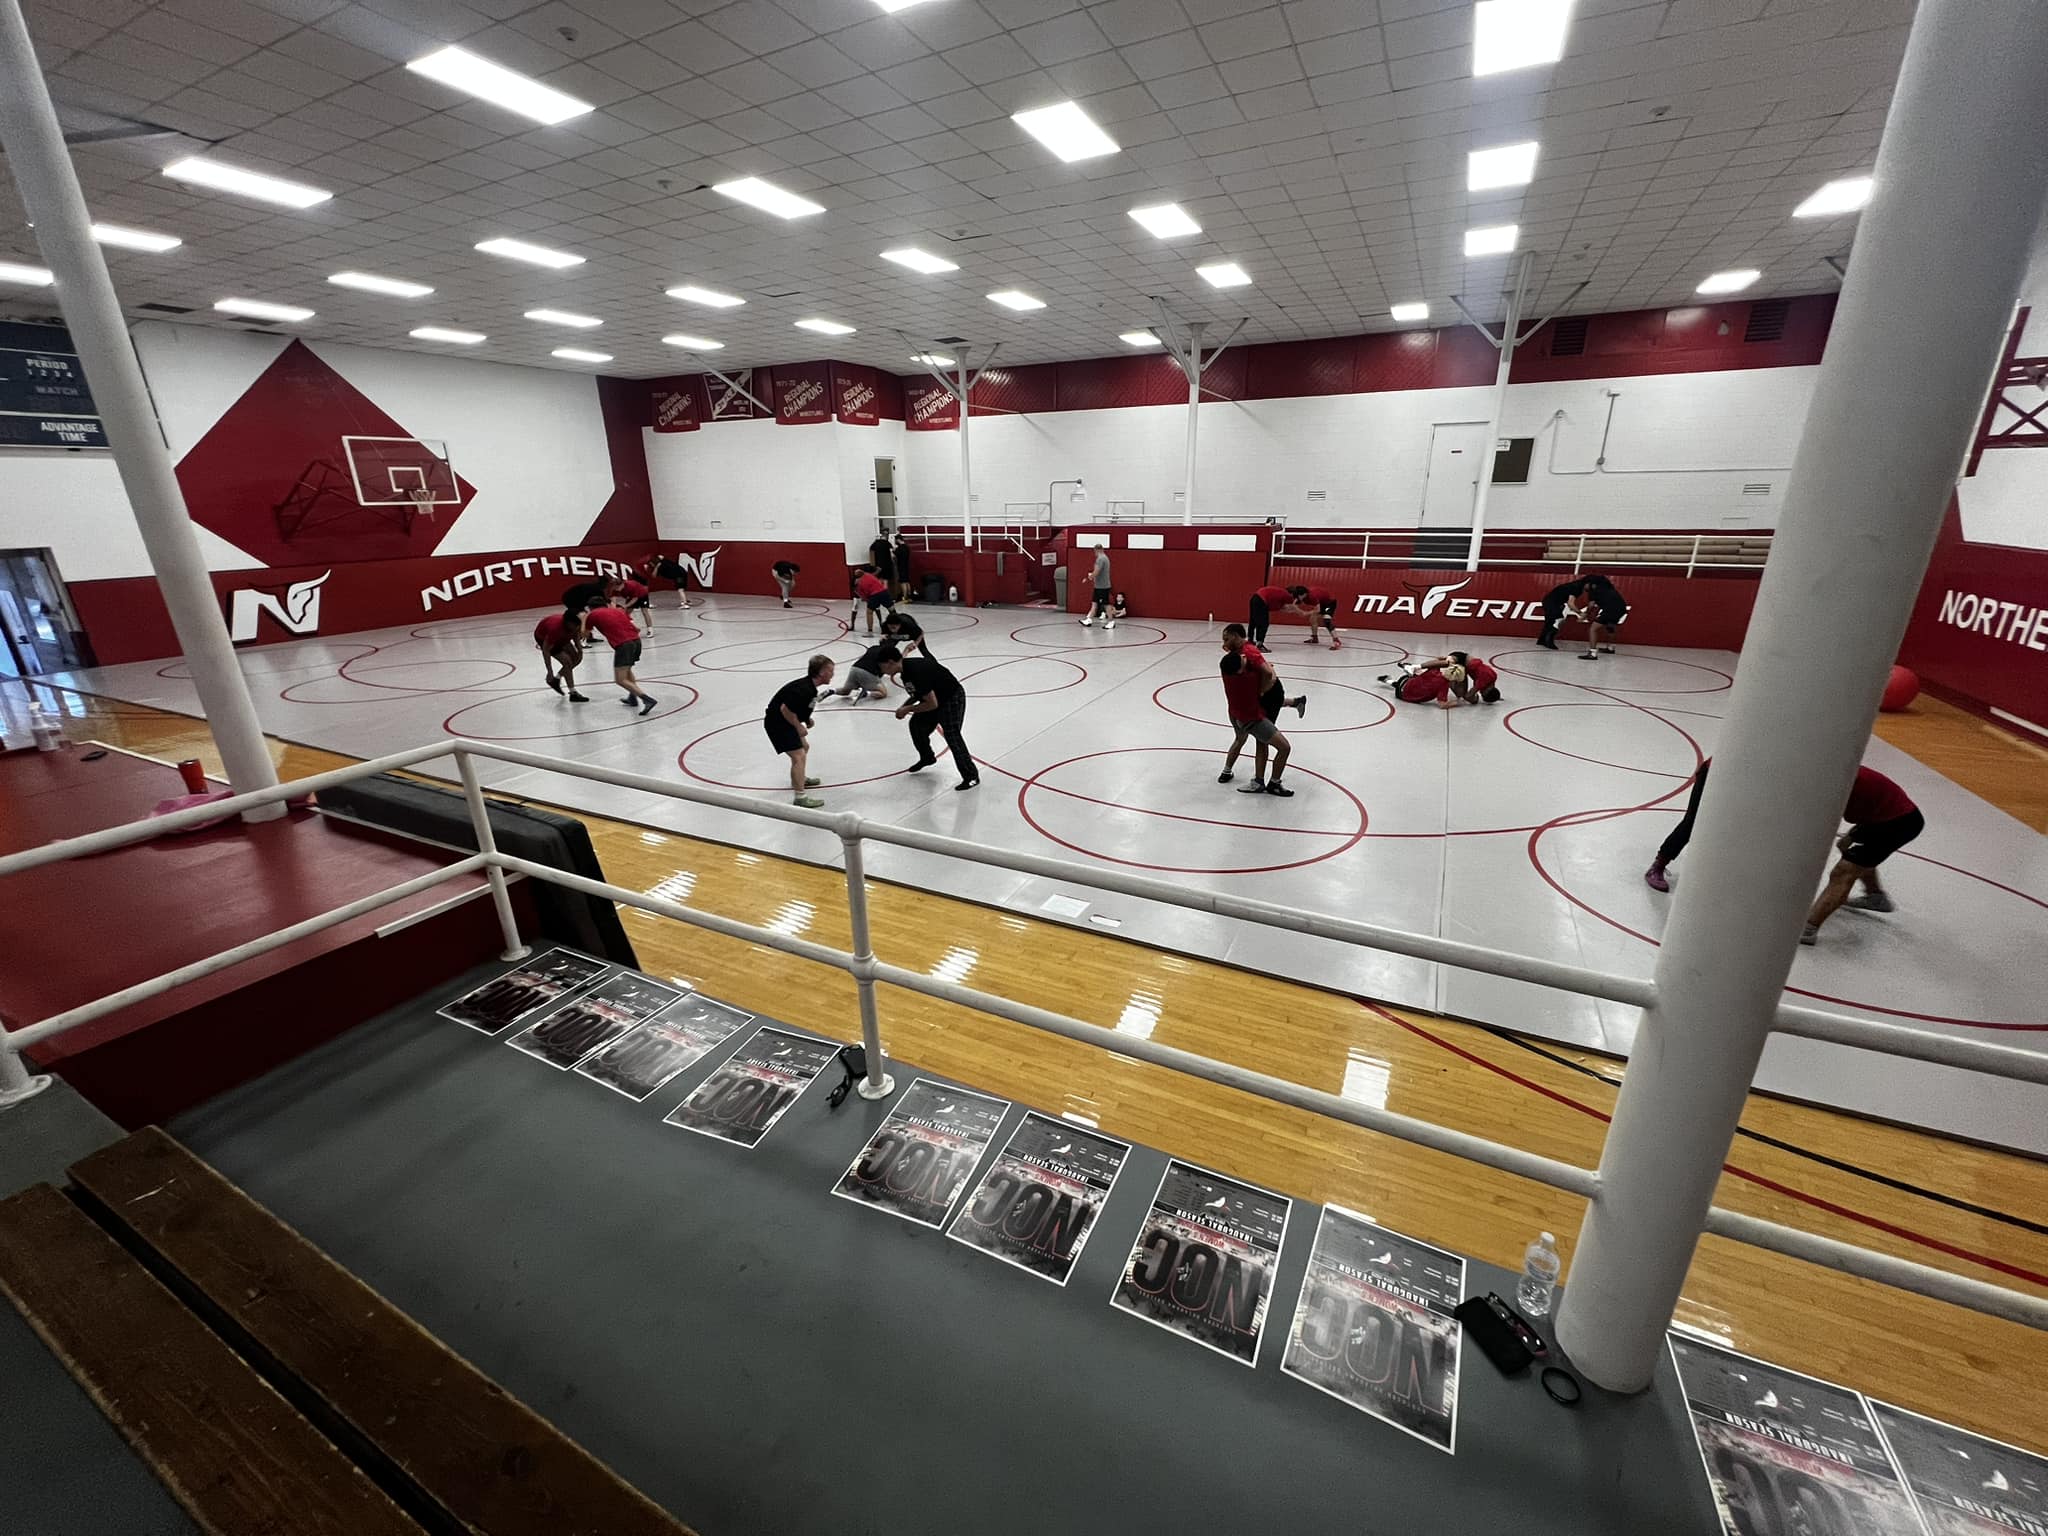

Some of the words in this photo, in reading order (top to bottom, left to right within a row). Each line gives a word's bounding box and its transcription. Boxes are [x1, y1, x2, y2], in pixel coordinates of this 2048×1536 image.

[26, 359, 68, 370] PERIOD
[783, 382, 824, 418] CHAMPIONS
[784, 379, 812, 403] REGIONAL
[842, 387, 875, 416] CHAMPIONS
[914, 388, 942, 411] REGIONAL
[658, 394, 692, 426] CHAMPIONS
[914, 391, 954, 424] CHAMPIONS
[41, 421, 99, 433] ADVANTAGE
[58, 432, 88, 442] TIME
[1354, 577, 1632, 625] MAVERIC
[1938, 590, 2048, 652] NORTHE
[1022, 1154, 1050, 1169] SEASON
[971, 1173, 1091, 1260] NOC
[1175, 1208, 1207, 1227] SEASON
[1208, 1219, 1254, 1243] INAUGURAL
[1132, 1230, 1264, 1335] NOC
[1338, 1263, 1376, 1284] SEASON
[1376, 1277, 1430, 1308] INAUGURAL
[1301, 1288, 1446, 1415] NOC
[1724, 1411, 1776, 1438] SEASON
[1777, 1430, 1855, 1466] INAUGURAL
[1952, 1495, 2015, 1527] SEASON
